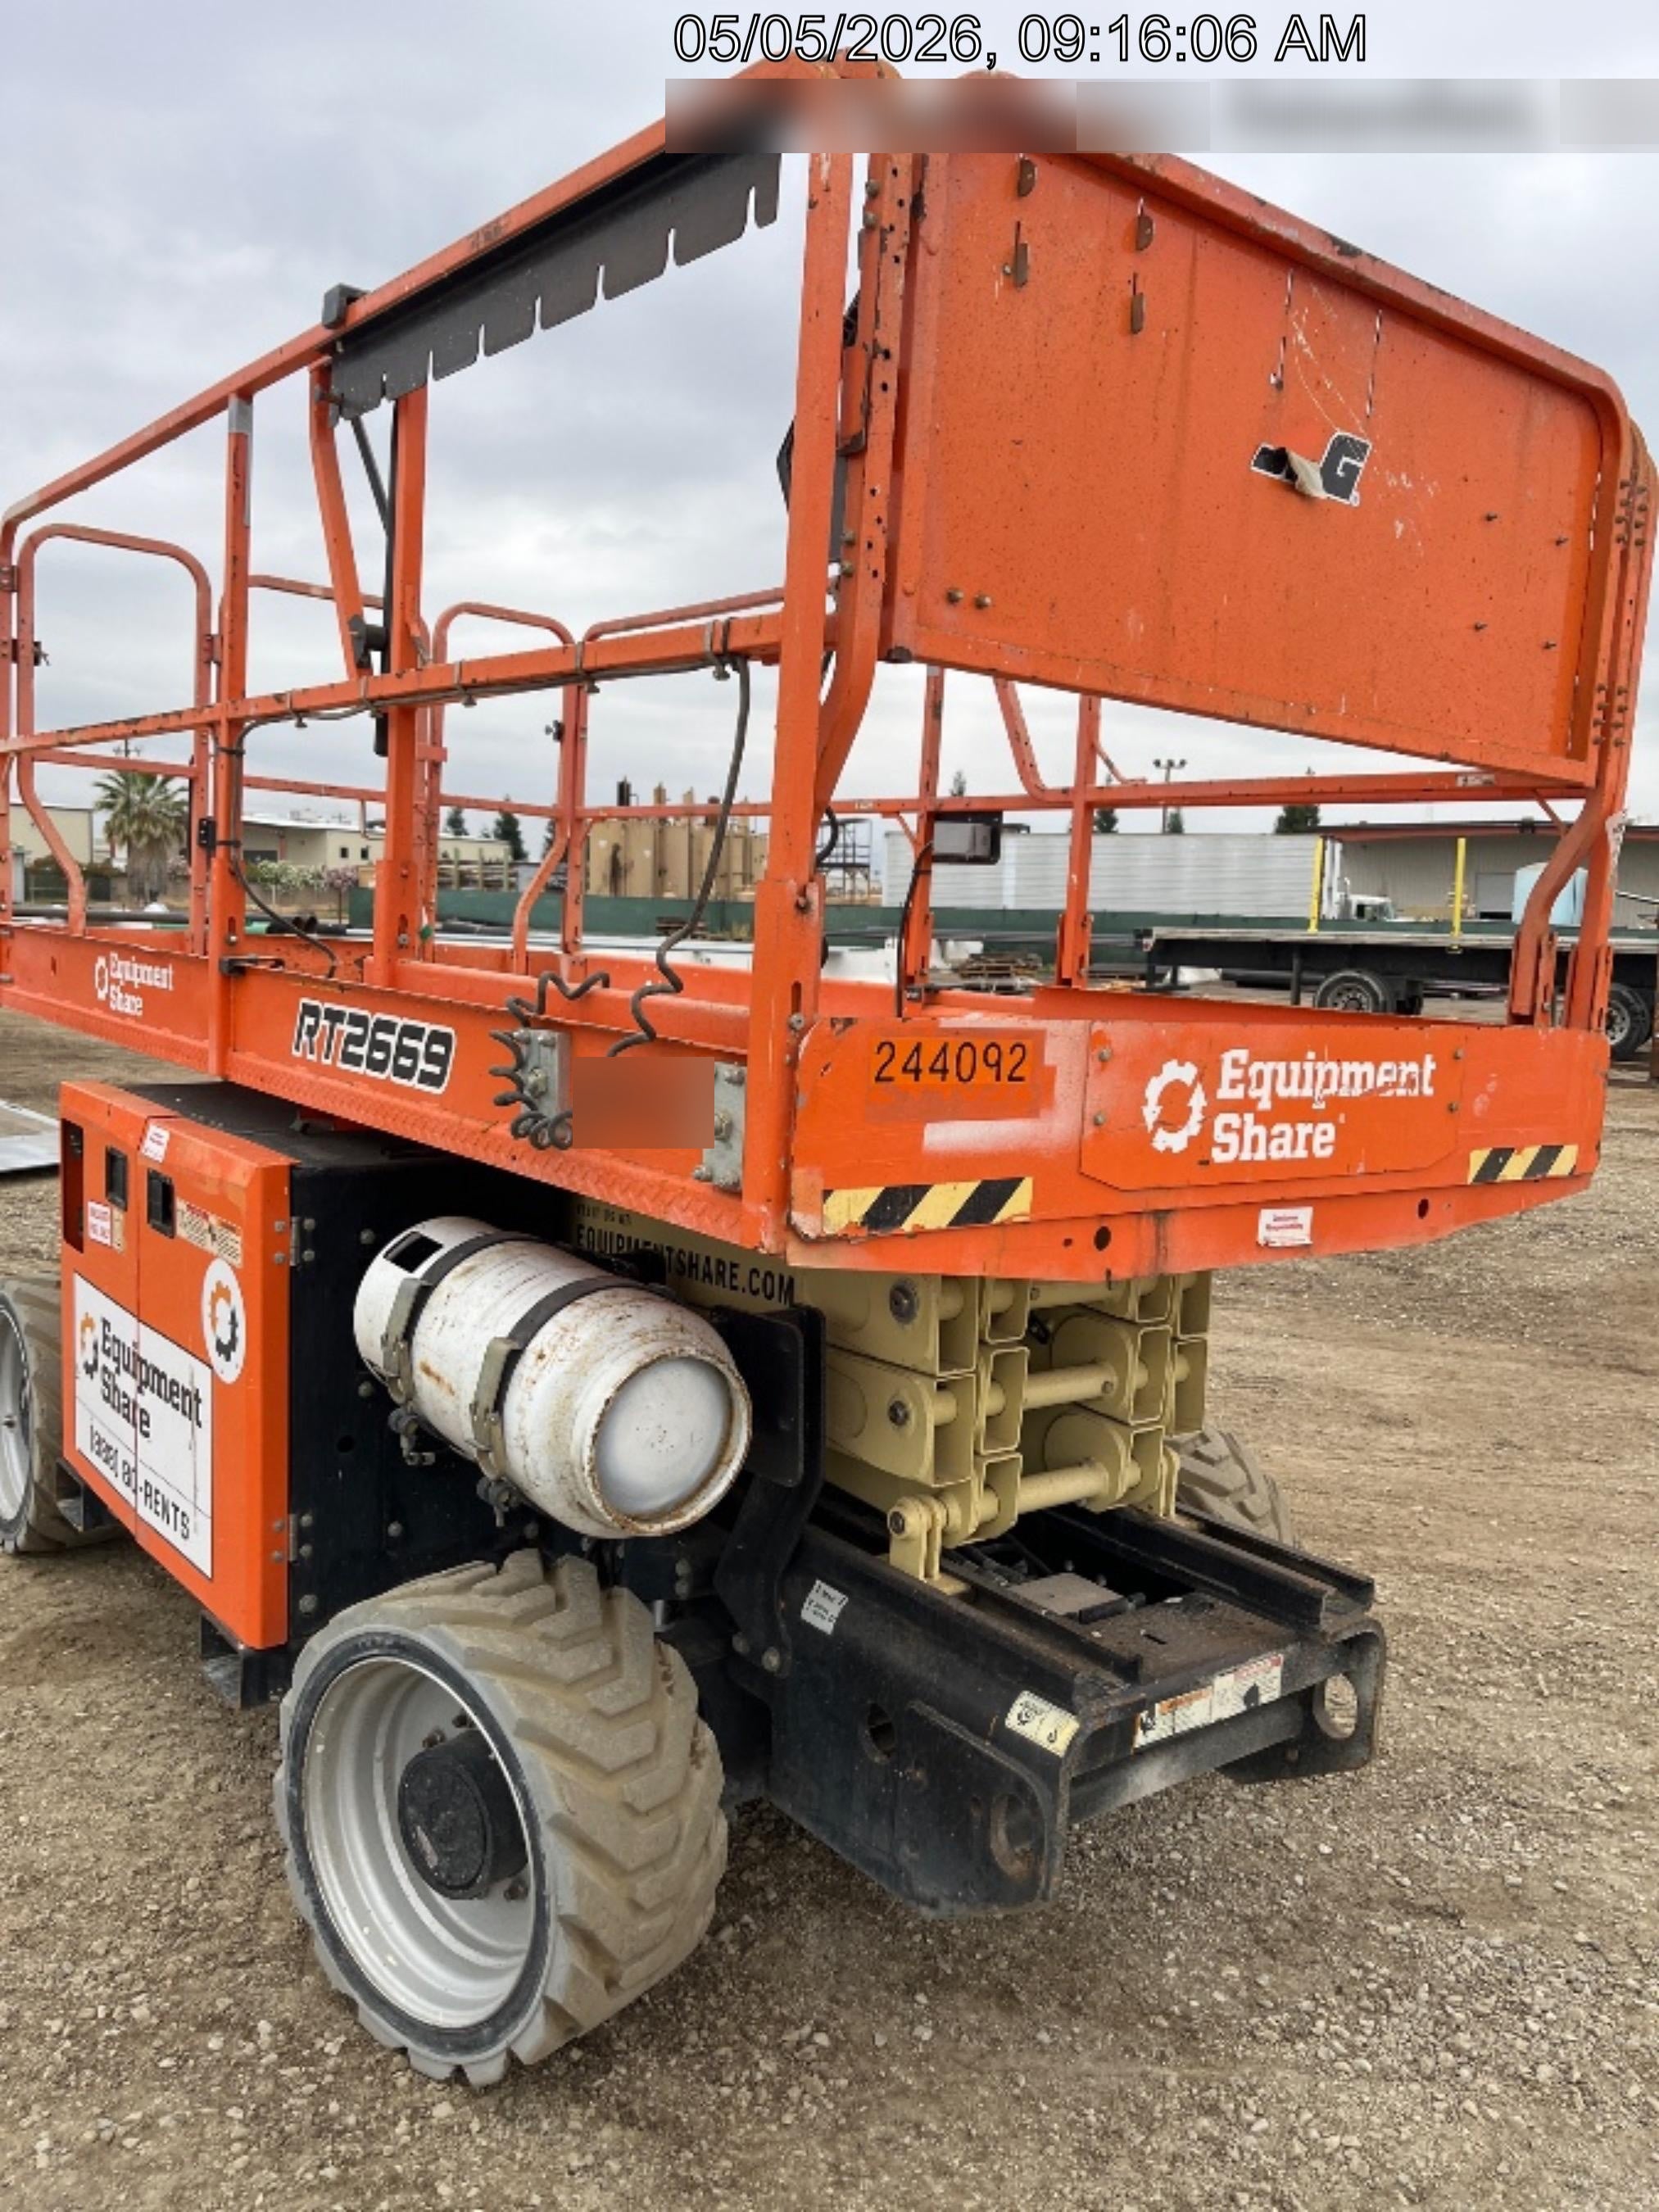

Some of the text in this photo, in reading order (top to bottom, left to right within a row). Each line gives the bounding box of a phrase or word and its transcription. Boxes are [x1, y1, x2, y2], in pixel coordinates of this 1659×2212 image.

[110, 951, 173, 991] Equipment
[110, 984, 143, 1017] Share
[292, 998, 456, 1094] RT2669
[874, 1040, 1027, 1083] 244092
[1217, 1049, 1436, 1110] Equipment
[1211, 1112, 1336, 1163] Share
[101, 1316, 202, 1428] Equipment
[101, 1365, 151, 1439] Share
